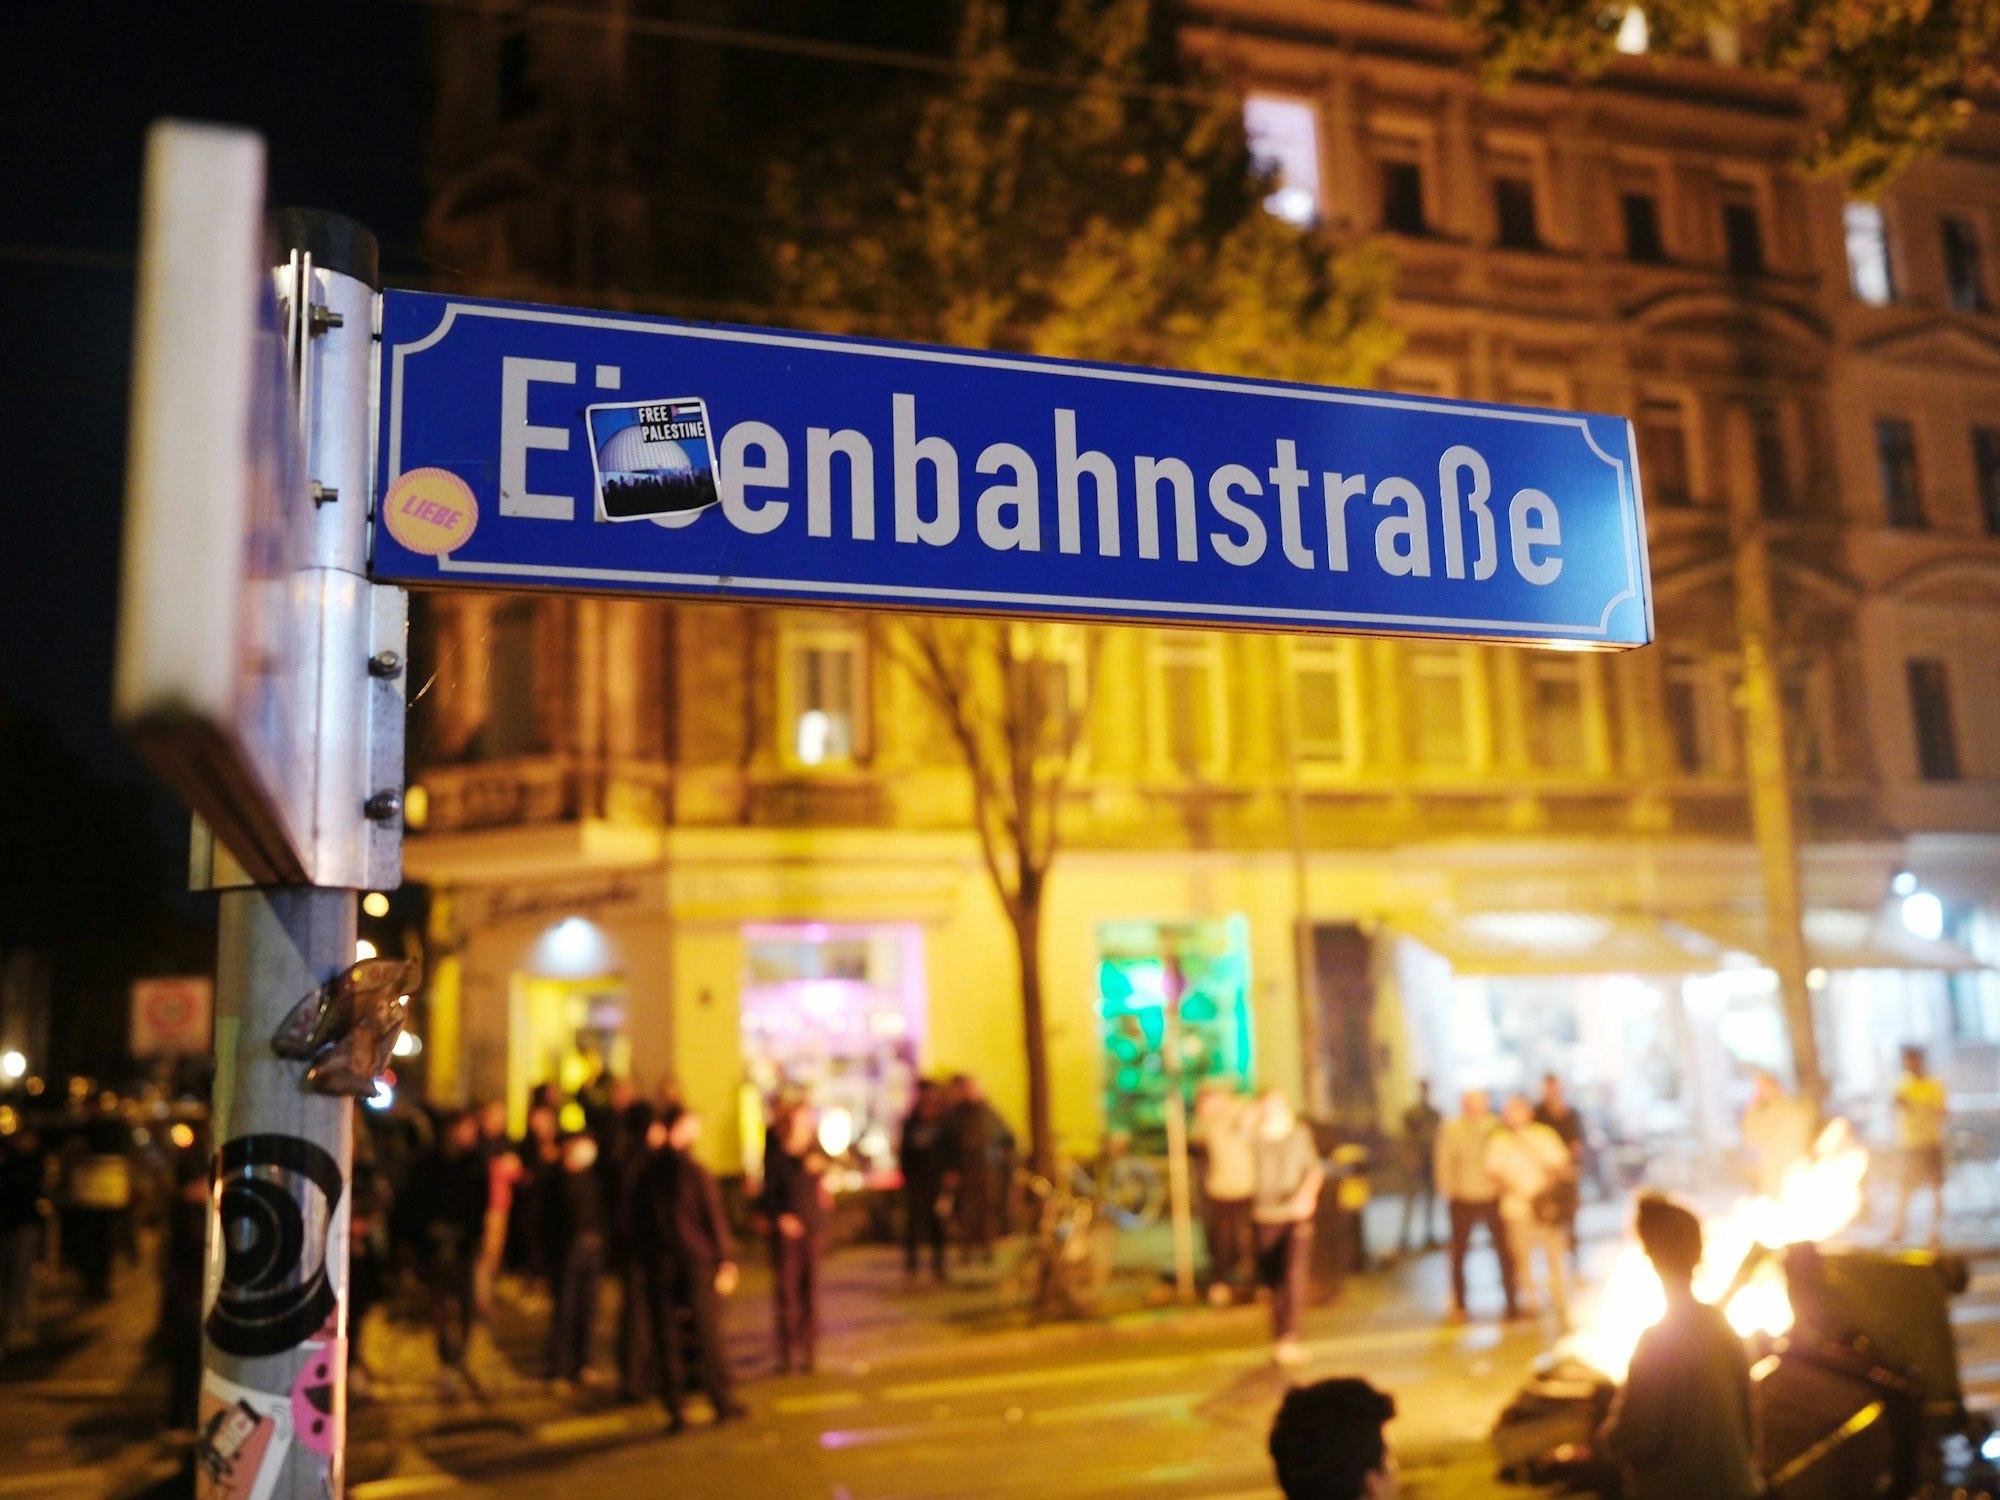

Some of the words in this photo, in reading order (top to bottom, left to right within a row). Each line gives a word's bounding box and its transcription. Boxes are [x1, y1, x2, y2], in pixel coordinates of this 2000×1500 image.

[638, 405, 669, 423] FREE
[641, 421, 705, 442] PALESTINE
[500, 356, 1563, 586] Eenbahnstraße
[401, 494, 464, 530] LIEBE
